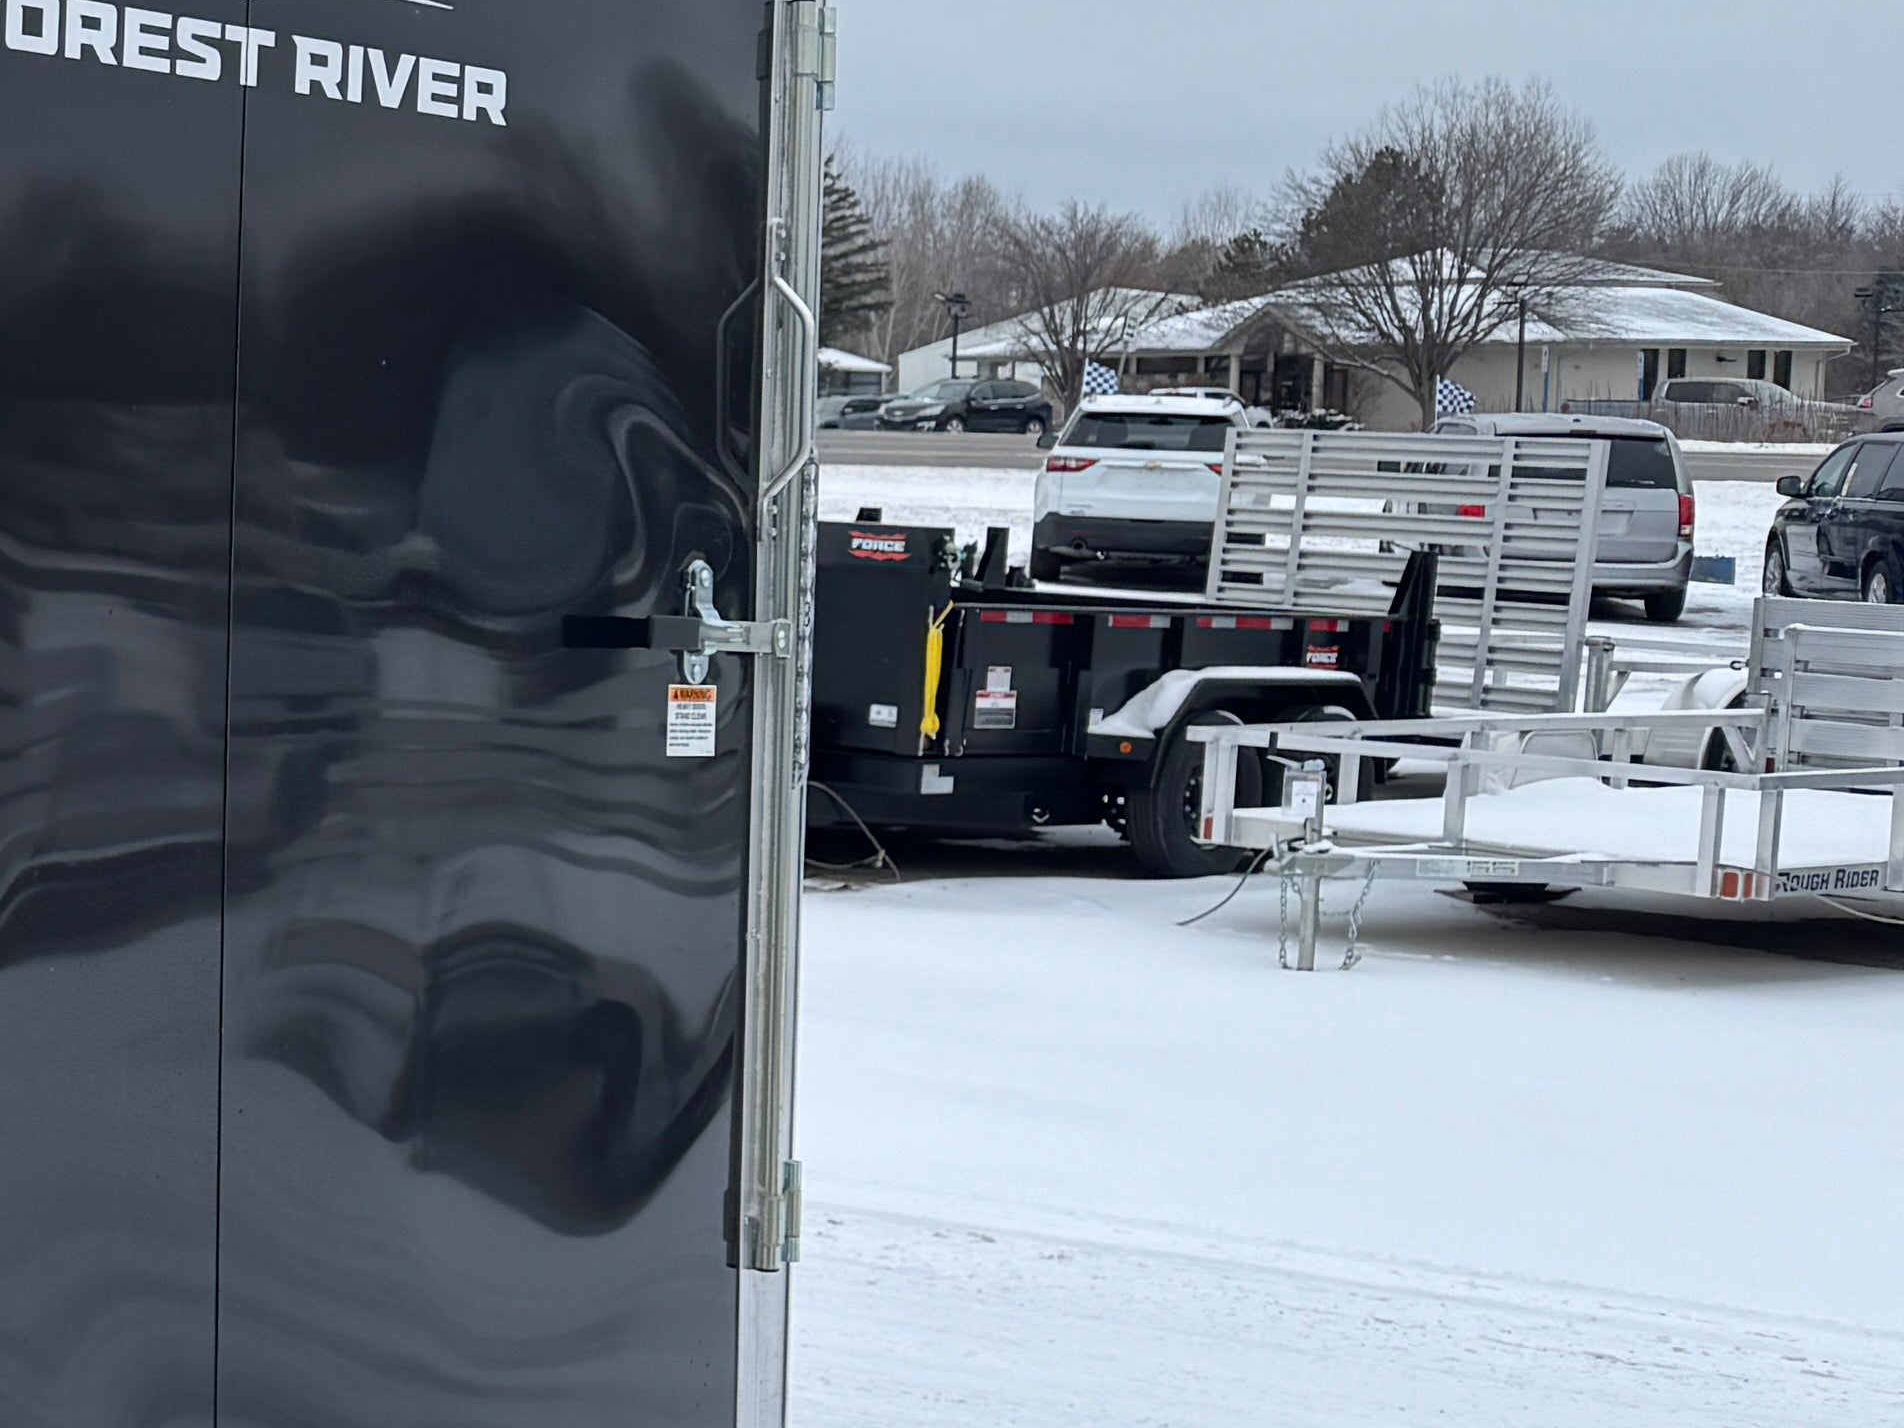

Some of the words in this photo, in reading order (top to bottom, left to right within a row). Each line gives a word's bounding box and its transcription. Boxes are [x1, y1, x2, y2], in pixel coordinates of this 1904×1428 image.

[292, 34, 507, 126] RIVER
[851, 538, 906, 552] FORCE
[1775, 872, 1831, 892] ROUGH
[1834, 868, 1880, 889] RIDER
